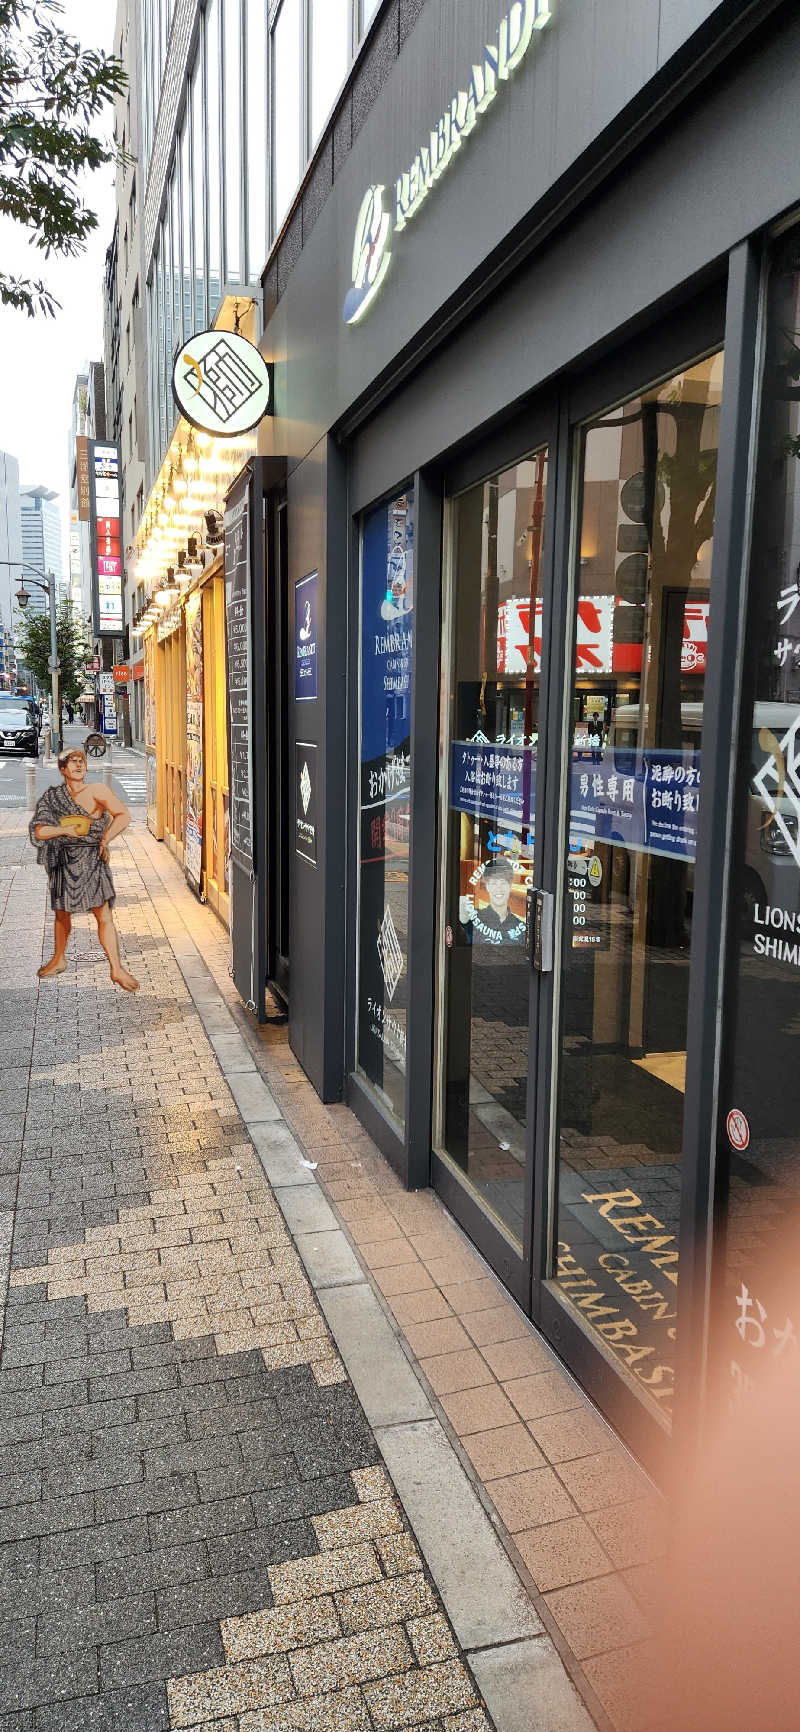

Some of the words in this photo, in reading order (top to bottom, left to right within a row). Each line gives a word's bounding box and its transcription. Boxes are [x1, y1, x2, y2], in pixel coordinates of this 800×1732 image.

[579, 773, 636, 803] 男性専用
[753, 934, 800, 967] SHIM
[580, 1188, 680, 1286] REM
[598, 1253, 677, 1321] CABIN
